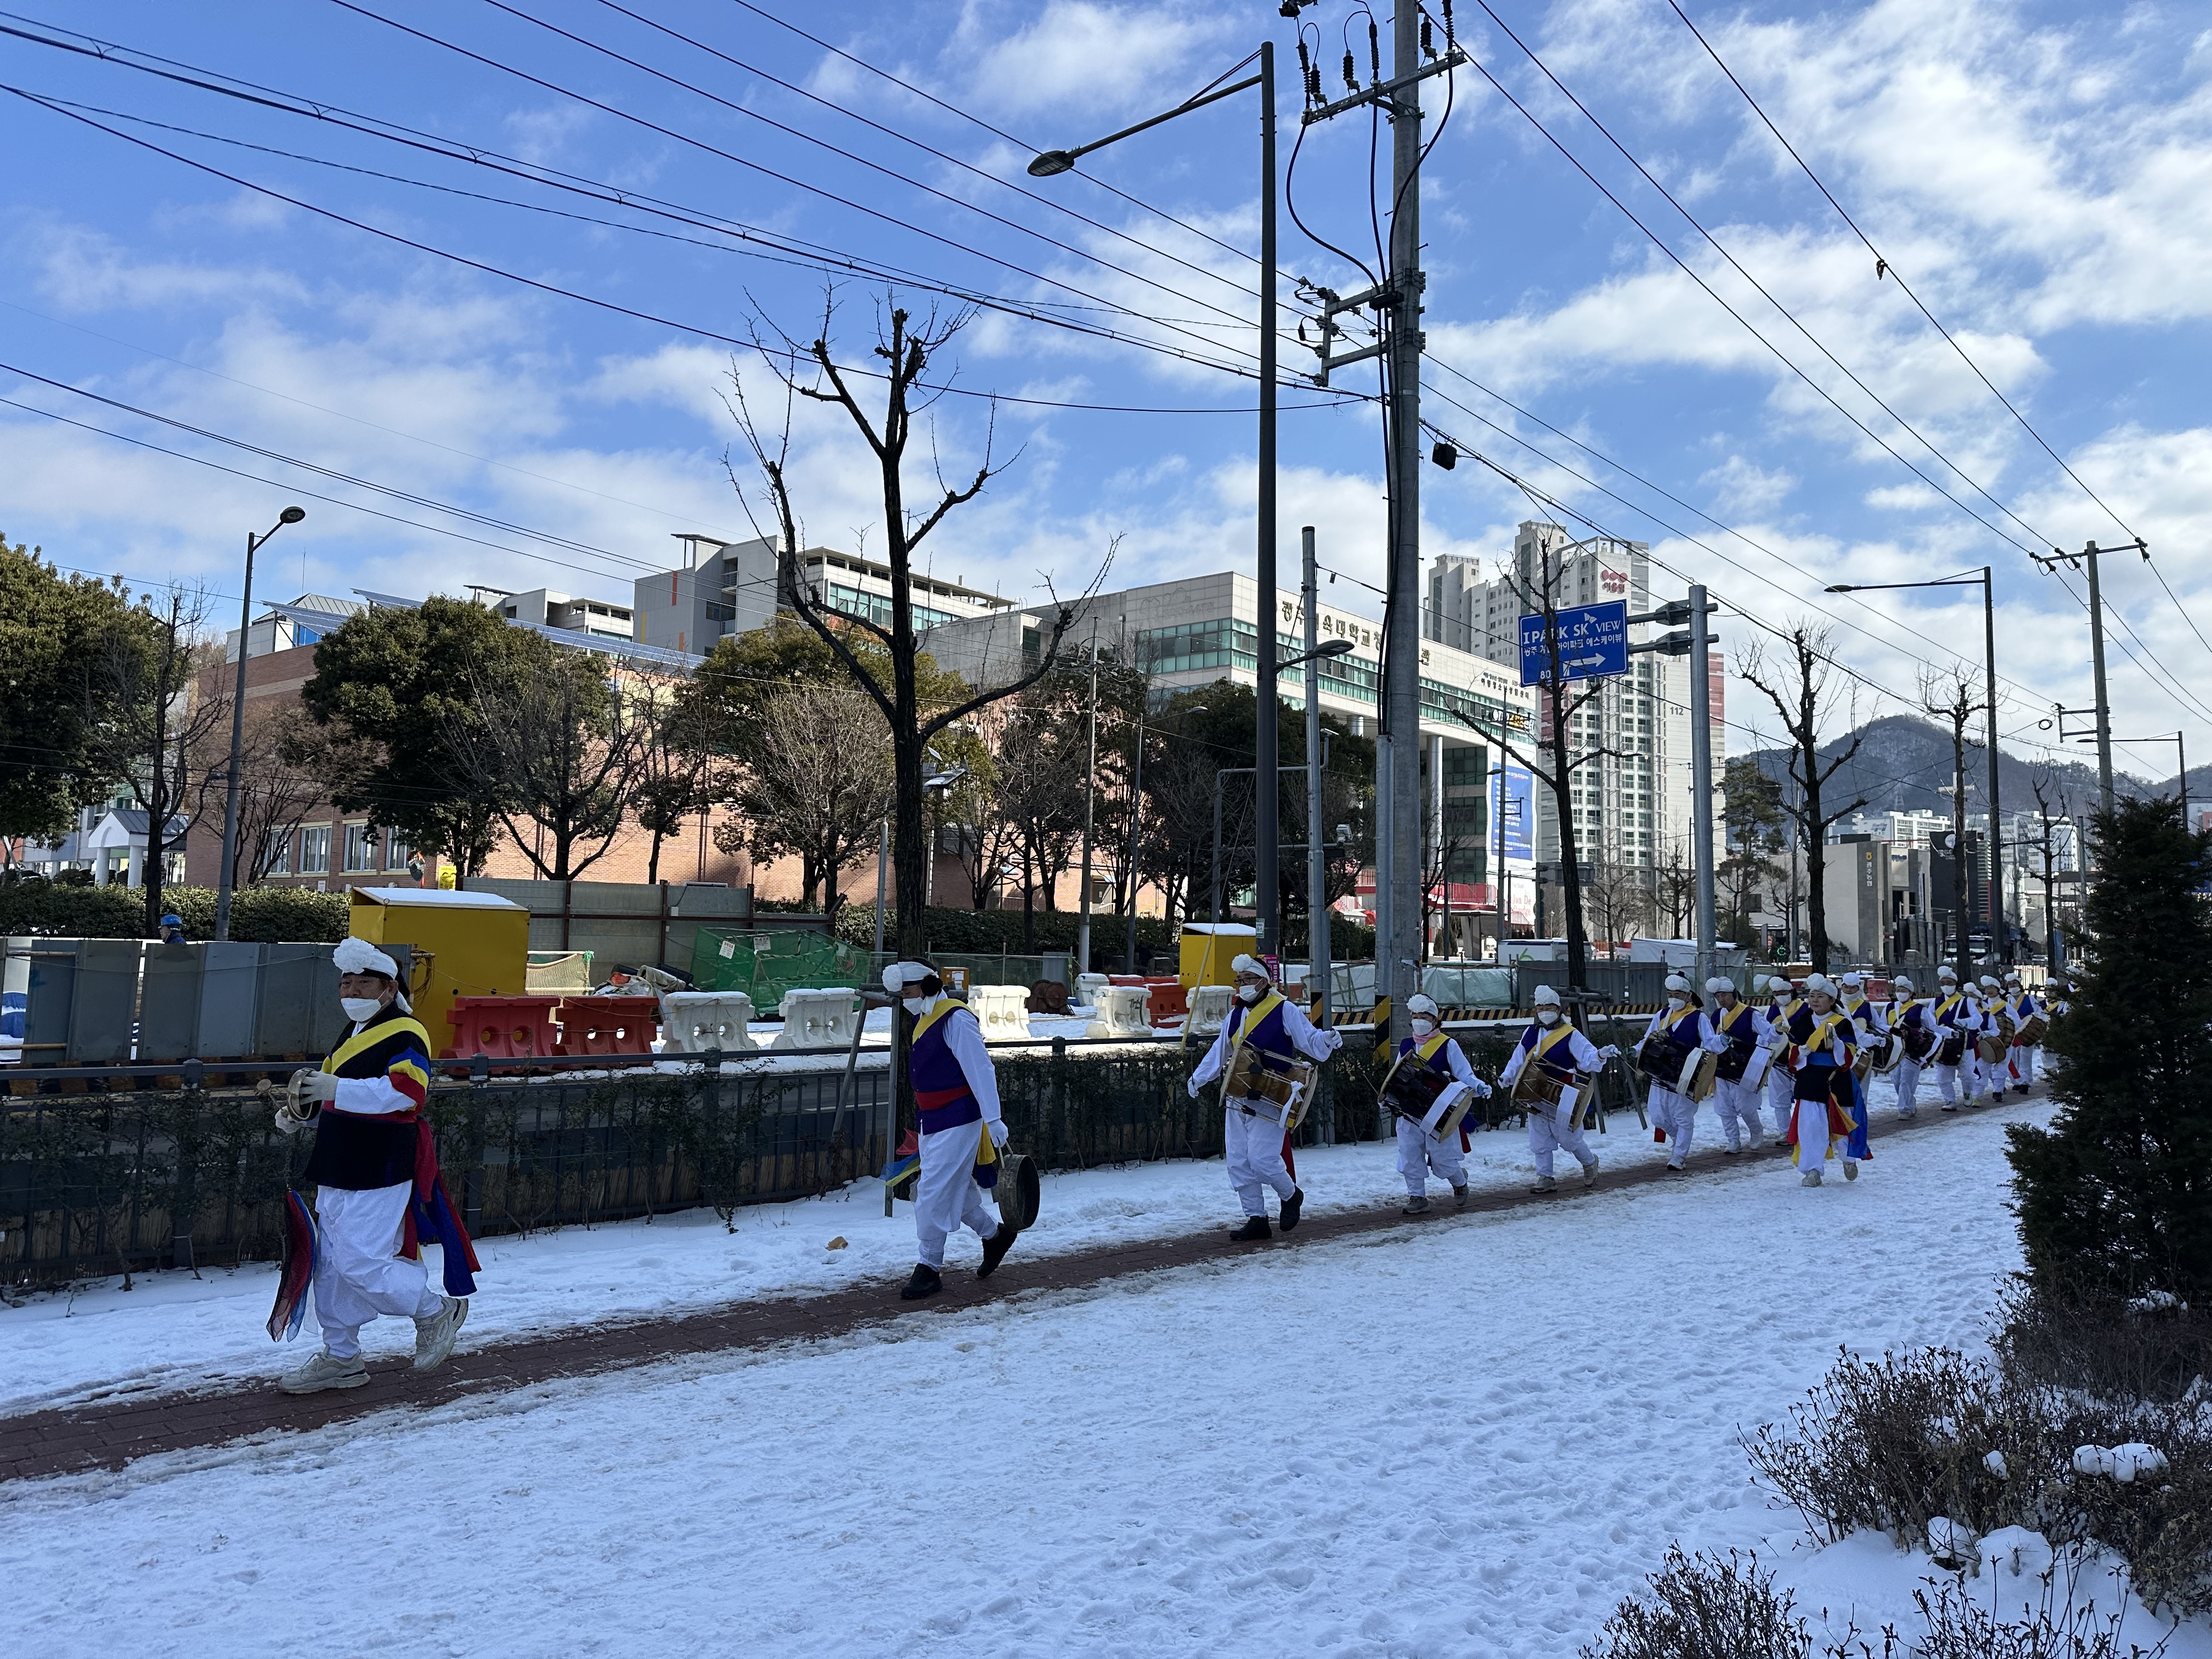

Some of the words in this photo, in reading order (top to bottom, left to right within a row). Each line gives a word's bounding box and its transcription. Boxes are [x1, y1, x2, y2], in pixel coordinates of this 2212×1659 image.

[1573, 623, 1589, 636] SK
[1595, 619, 1621, 633] VIEW
[1586, 633, 1622, 647] 에스케이뷰
[1670, 706, 1684, 715] 112
